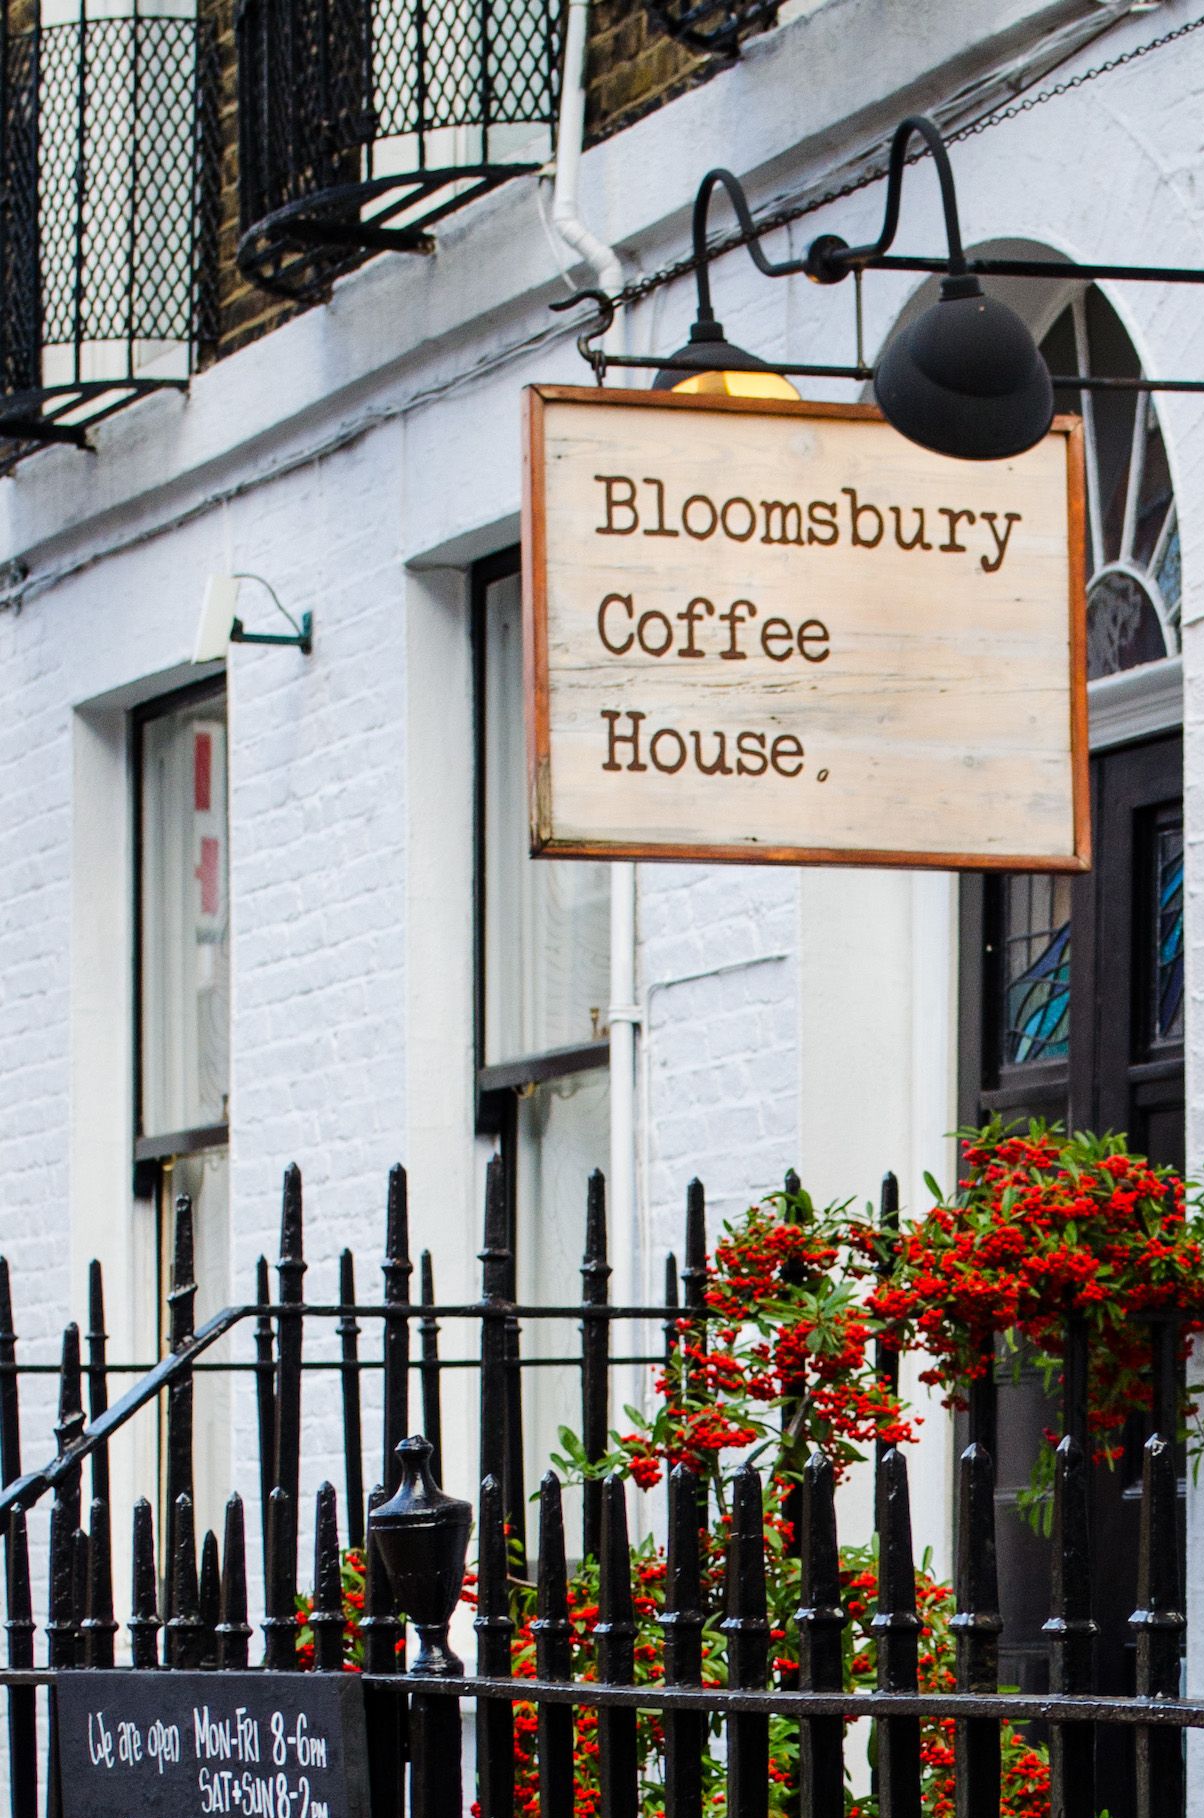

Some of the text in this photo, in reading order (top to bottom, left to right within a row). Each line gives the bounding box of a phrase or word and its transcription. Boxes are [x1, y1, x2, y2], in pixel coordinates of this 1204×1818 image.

[594, 474, 1021, 573] Bloomsbury
[597, 592, 831, 664] Coffee
[88, 1712, 114, 1768] We
[118, 1721, 142, 1766] are
[148, 1719, 180, 1775] open
